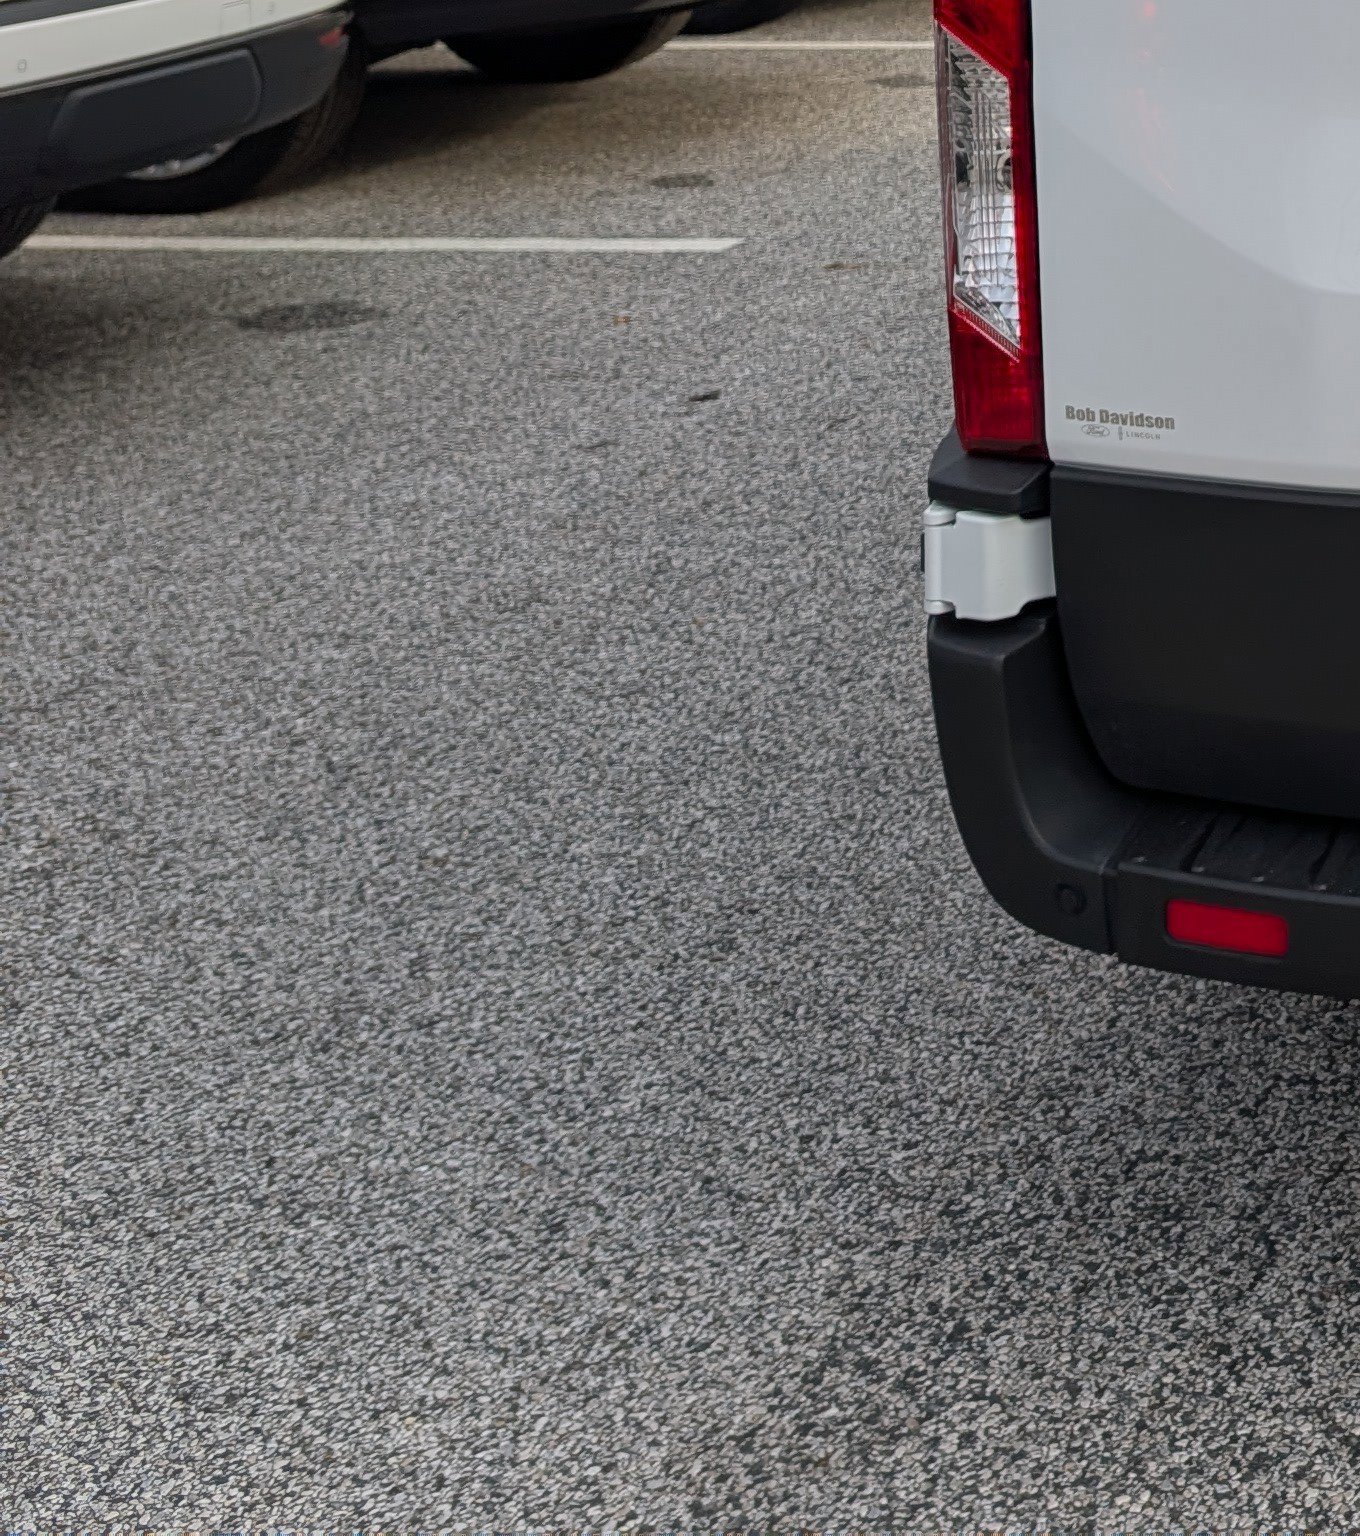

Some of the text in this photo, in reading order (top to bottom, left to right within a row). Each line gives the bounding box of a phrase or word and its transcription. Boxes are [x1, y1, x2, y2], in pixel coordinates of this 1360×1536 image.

[1065, 405, 1175, 430] Bob Davidson
[1125, 431, 1160, 440] LINCOLN
